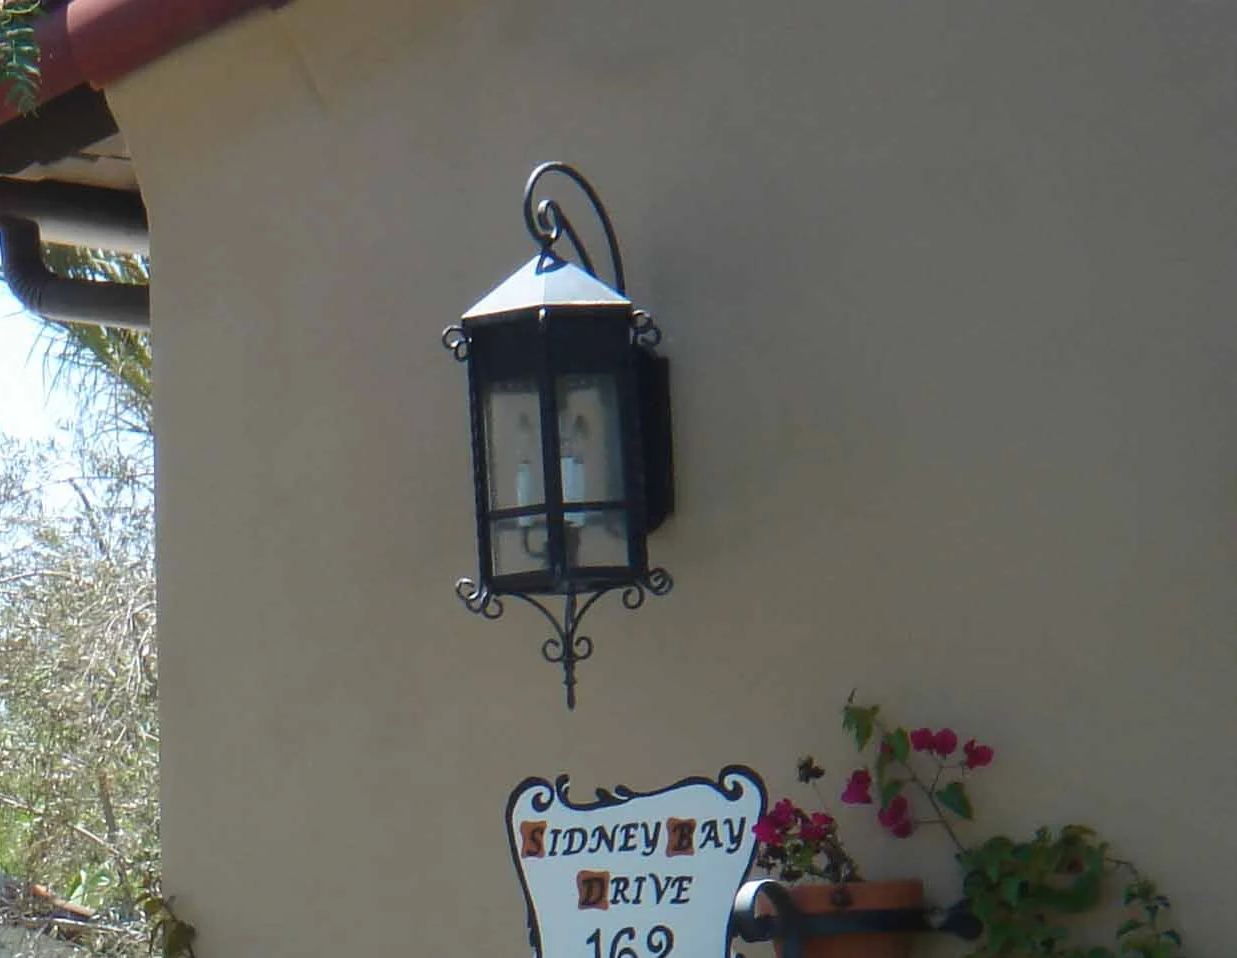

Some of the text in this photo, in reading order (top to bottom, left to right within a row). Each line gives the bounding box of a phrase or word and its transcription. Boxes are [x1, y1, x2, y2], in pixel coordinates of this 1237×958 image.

[526, 817, 746, 857] SIDNEY BAY
[581, 873, 693, 906] DRIVE
